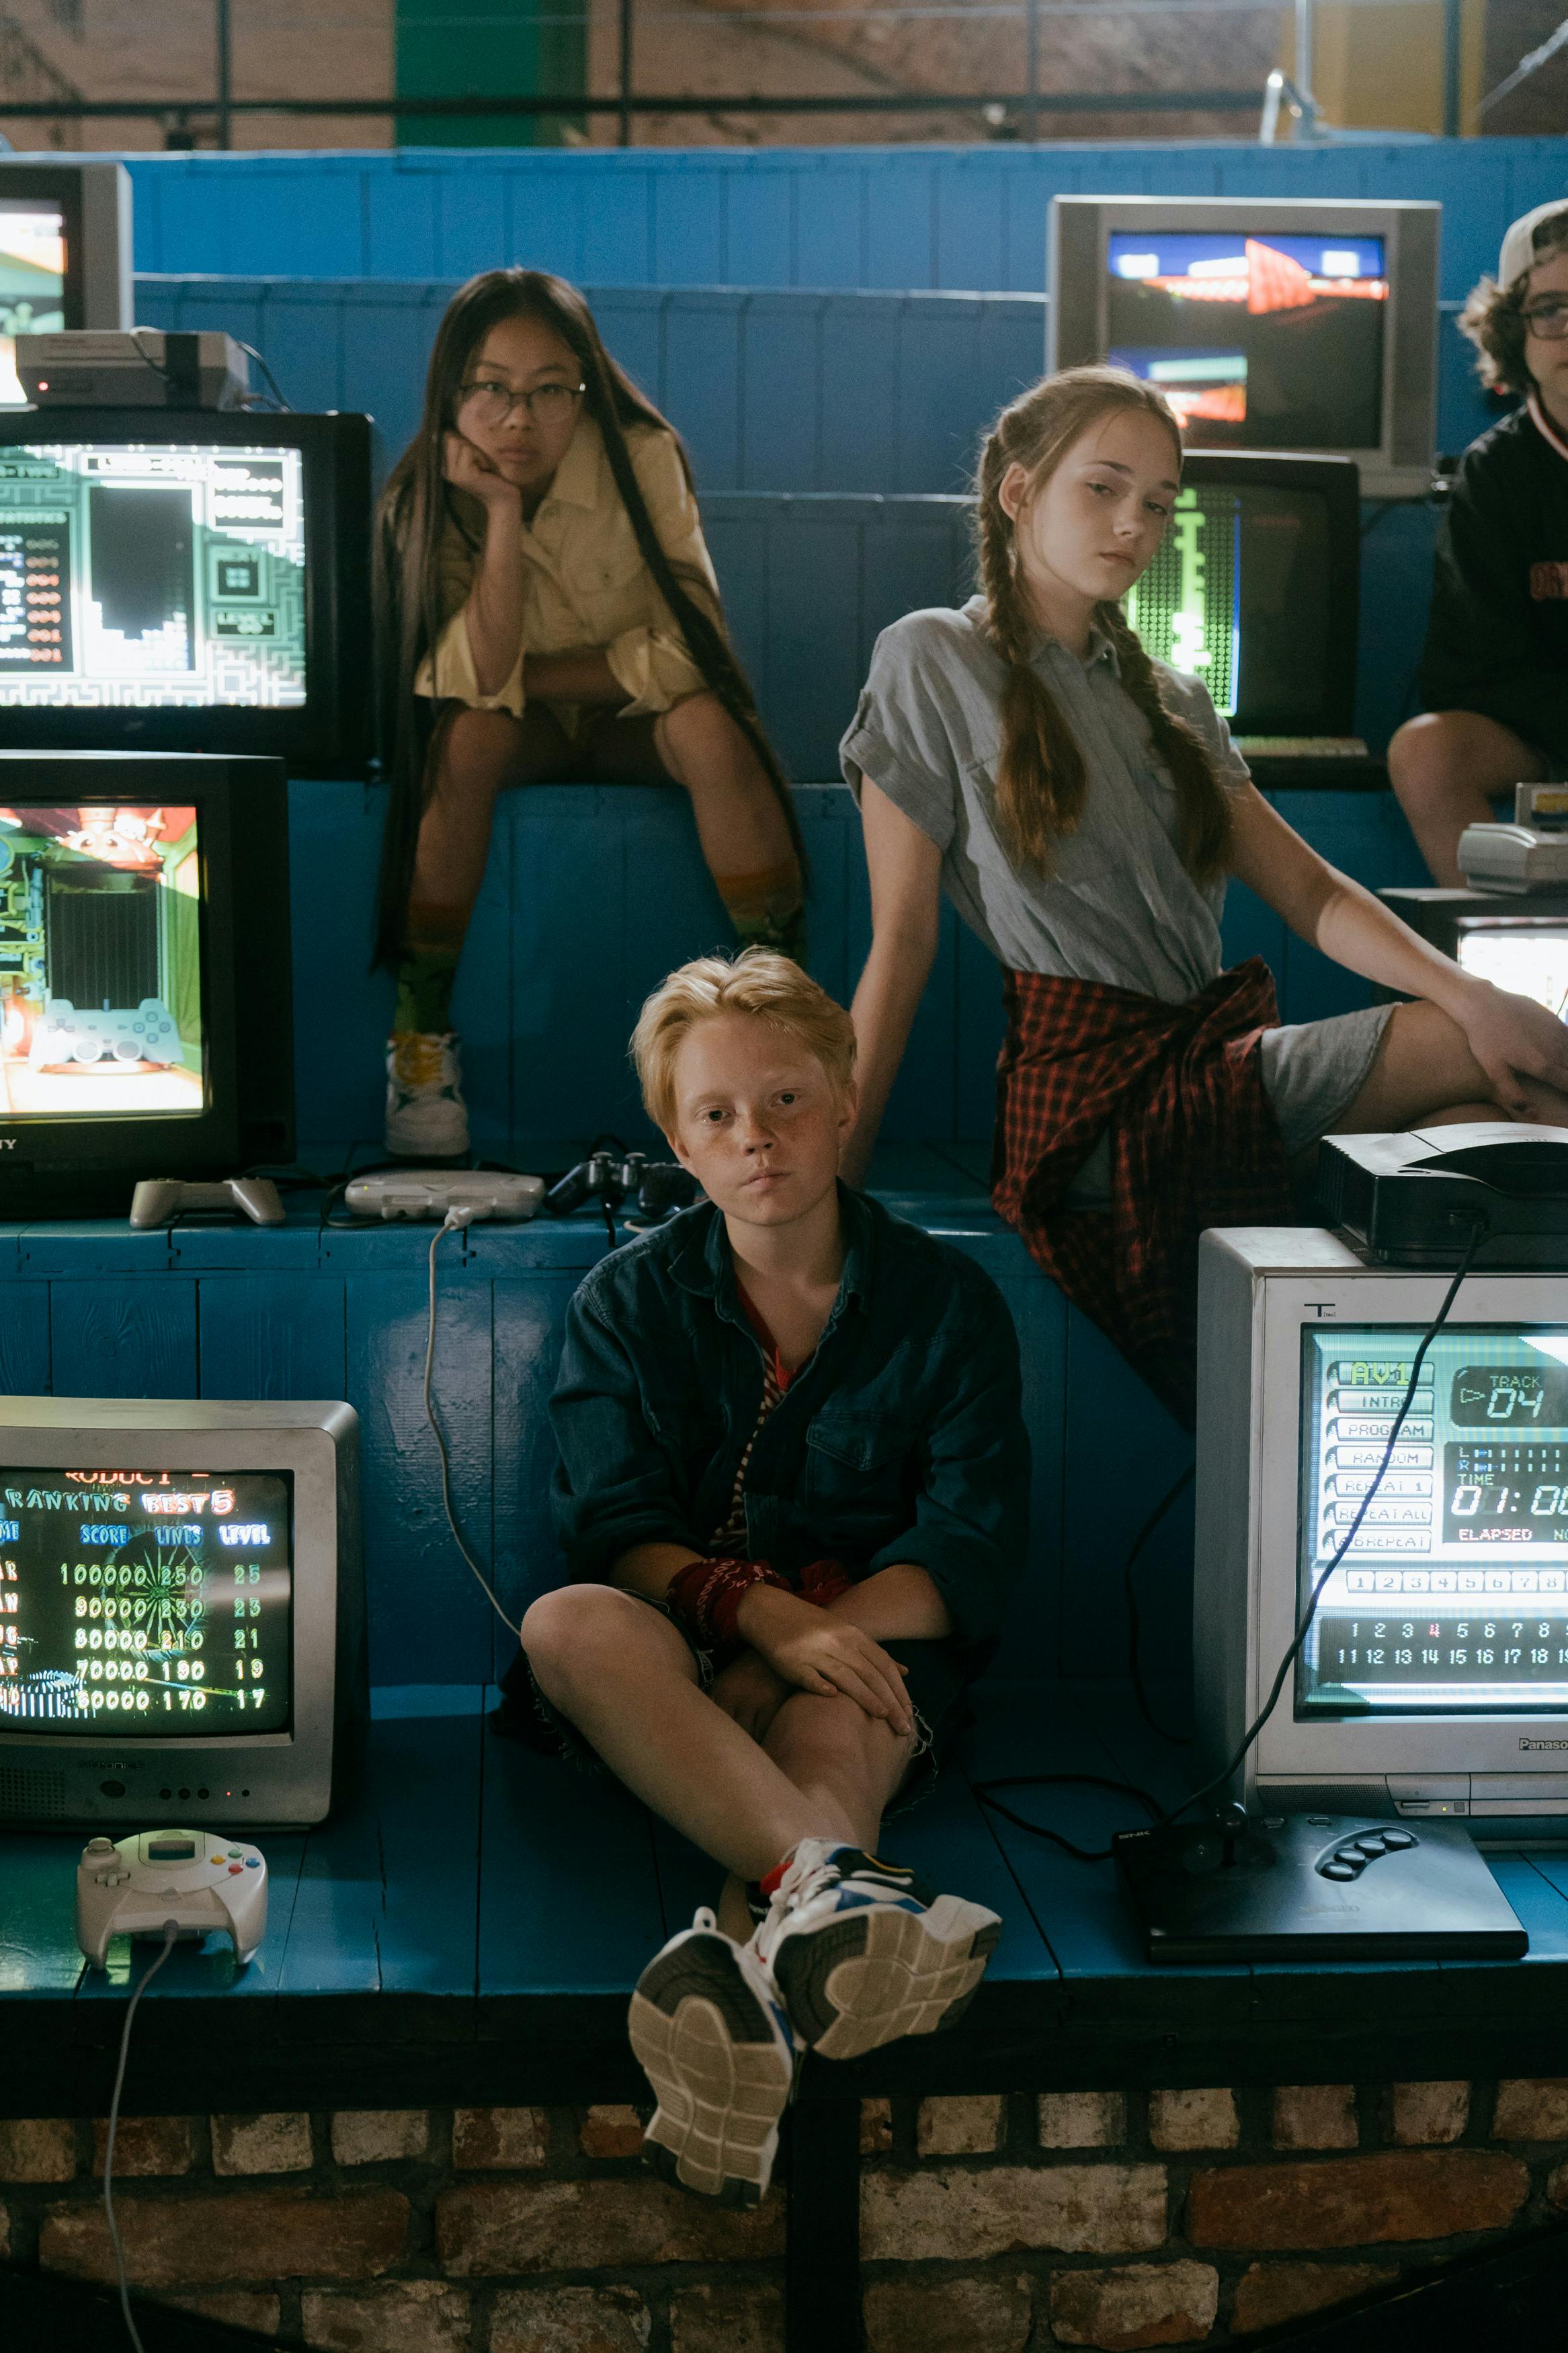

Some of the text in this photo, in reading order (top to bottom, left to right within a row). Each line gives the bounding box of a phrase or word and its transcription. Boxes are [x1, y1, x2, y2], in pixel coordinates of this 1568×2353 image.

[1351, 1362, 1409, 1385] AV1
[1489, 1375, 1542, 1388] TRACK
[1362, 1396, 1406, 1408] INTR
[1487, 1388, 1544, 1419] 04
[1349, 1424, 1424, 1436] PROGAM
[1415, 1482, 1422, 1491] 1
[1457, 1474, 1495, 1485] TIME
[5, 1488, 130, 1513] RANKING
[80, 1523, 129, 1545] SCORE
[154, 1525, 203, 1546] LINES
[218, 1523, 272, 1546] LEVEL
[1458, 1528, 1532, 1541] ELAPSED
[60, 1562, 147, 1587] 100000
[161, 1565, 203, 1586] 250
[234, 1564, 261, 1585] 25
[1357, 1577, 1557, 1588] 1 2 3 4 5 6 7 8
[75, 1596, 147, 1619] 90000
[161, 1597, 204, 1619] 230
[234, 1597, 261, 1618] 23
[75, 1628, 148, 1650] 80000
[161, 1630, 204, 1651] 210
[234, 1628, 258, 1649] 21
[1352, 1623, 1359, 1637] 1
[1374, 1622, 1387, 1637] 2
[1401, 1623, 1414, 1638] 3
[1429, 1623, 1440, 1638] 4
[1456, 1623, 1469, 1638] 5
[1484, 1622, 1496, 1638] 6
[1512, 1622, 1523, 1638] 7
[1538, 1622, 1551, 1638] 8
[1366, 1649, 1385, 1664] 12
[1395, 1649, 1413, 1664] 13
[1421, 1649, 1440, 1664] 14
[1450, 1648, 1467, 1664] 15
[1476, 1648, 1494, 1664] 16
[1504, 1648, 1522, 1664] 17
[1530, 1648, 1549, 1664] 18
[76, 1659, 149, 1681] 70000
[161, 1660, 205, 1681] 190
[235, 1658, 264, 1680] 19
[77, 1690, 150, 1711] 60000
[163, 1690, 206, 1711] 170
[237, 1688, 265, 1710] 17
